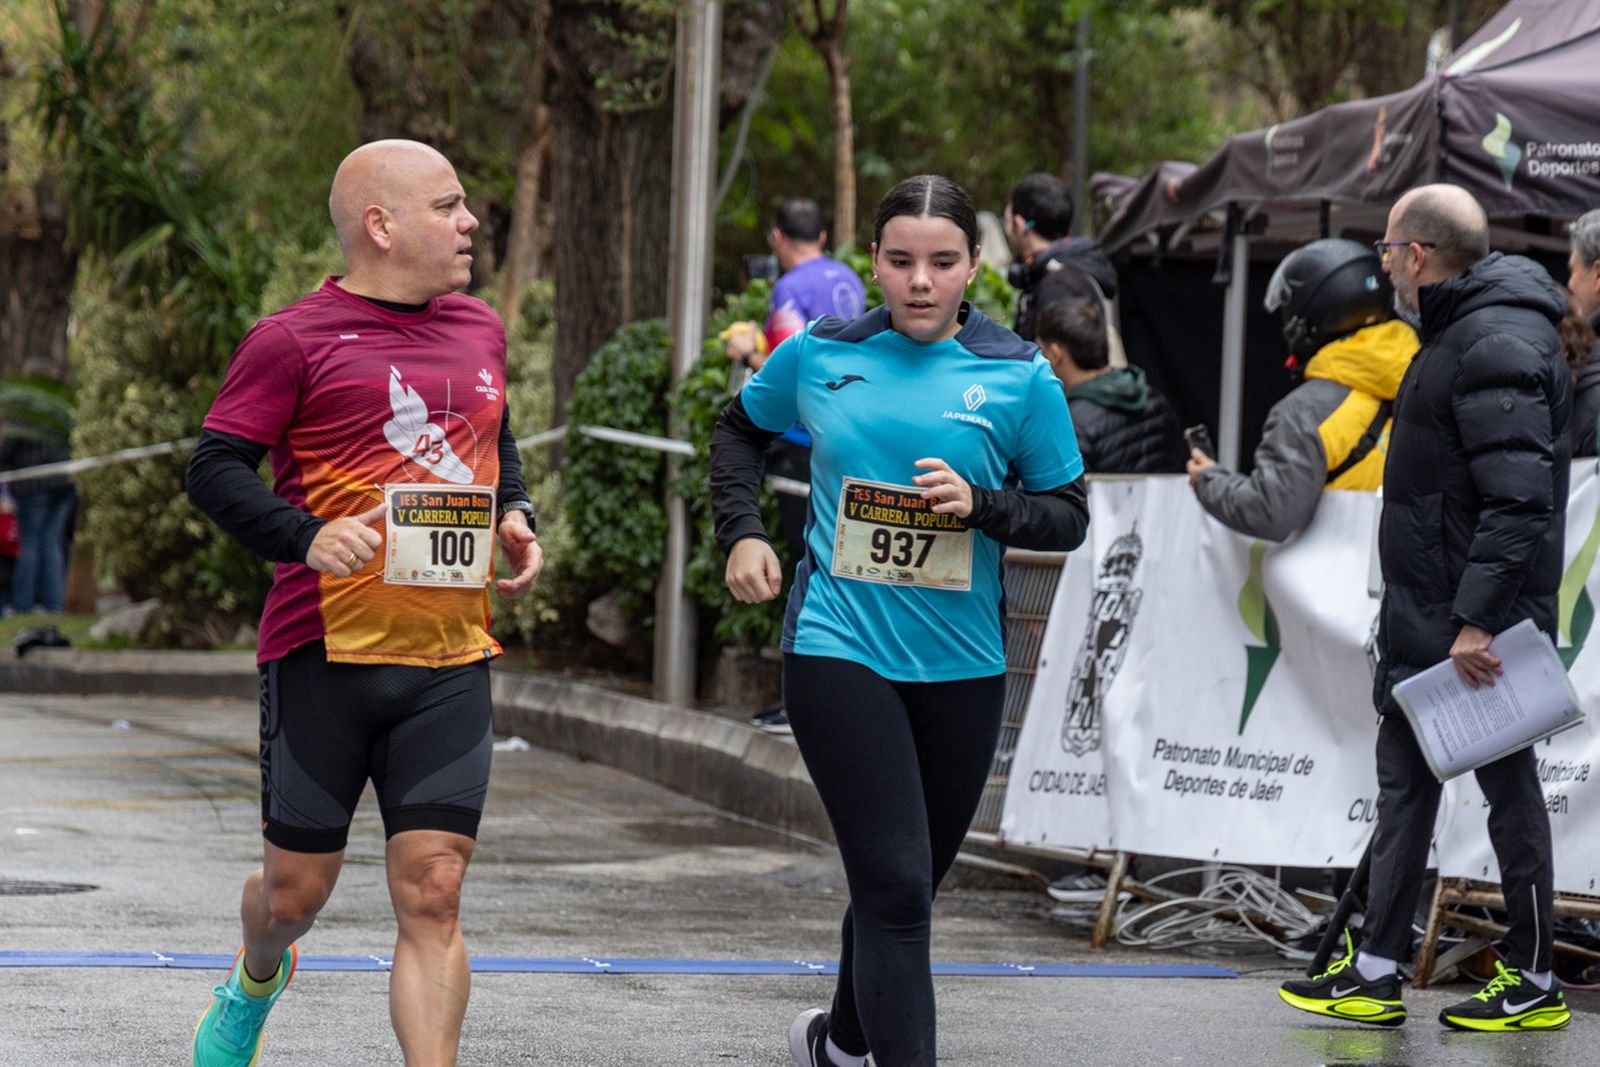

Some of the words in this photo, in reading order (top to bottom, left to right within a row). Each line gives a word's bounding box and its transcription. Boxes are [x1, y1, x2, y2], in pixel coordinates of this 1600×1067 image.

[1526, 141, 1600, 158] Patronato
[1528, 159, 1600, 178] Deportes
[413, 433, 444, 465] 43
[400, 493, 418, 507] IES
[421, 493, 443, 507] San
[446, 494, 470, 507] Juan
[874, 490, 894, 506] San
[898, 494, 926, 509] Juan
[397, 509, 406, 523] V
[409, 509, 459, 525] CARRERA
[849, 502, 858, 517] V
[860, 503, 911, 525] CARRERA
[914, 512, 965, 529] POPULA
[429, 530, 475, 567] 100
[870, 527, 937, 569] 937
[1152, 738, 1221, 768] Patronato
[1223, 745, 1292, 776] Municipal
[1293, 753, 1314, 777] de
[1028, 769, 1071, 795] CIUDAD
[1069, 771, 1087, 796] DE
[1163, 768, 1227, 798] Deportes
[1228, 776, 1249, 799] de
[1249, 777, 1284, 802] Jaén
